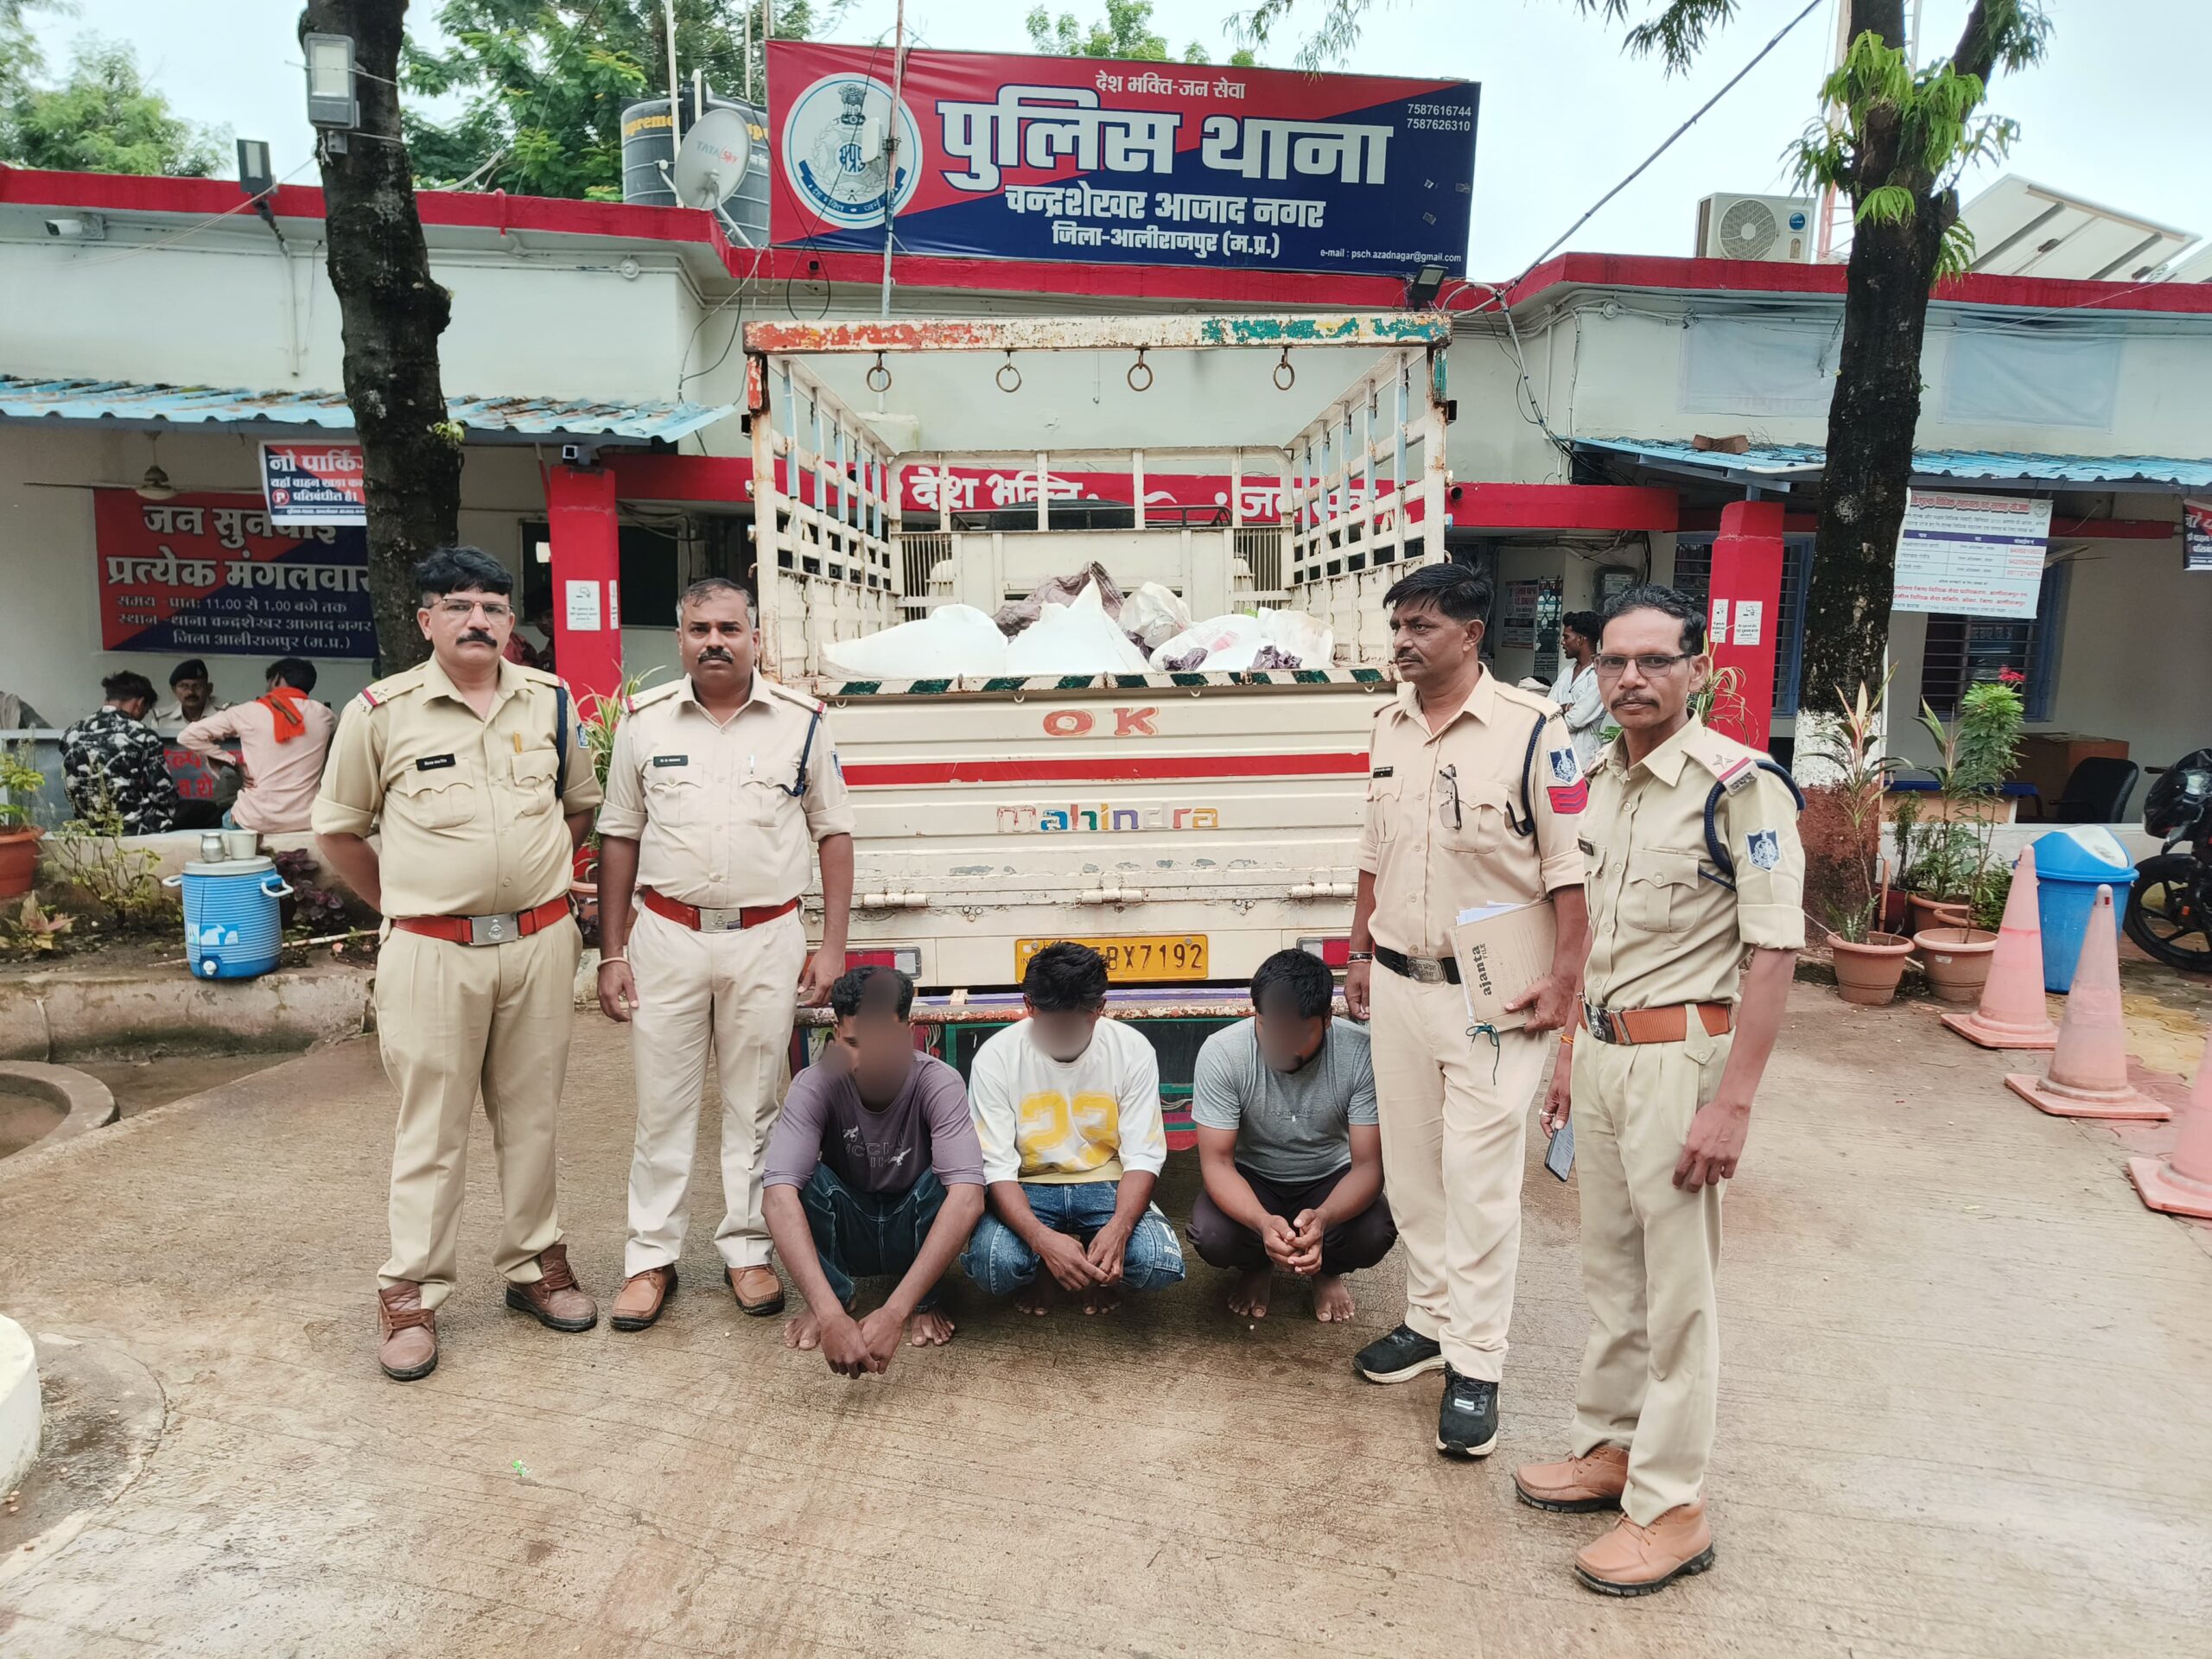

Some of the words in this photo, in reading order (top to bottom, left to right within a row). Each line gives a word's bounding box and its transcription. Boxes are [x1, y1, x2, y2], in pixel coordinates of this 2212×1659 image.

[1096, 70, 1122, 92] देश
[1212, 76, 1245, 99] सेवा
[1408, 103, 1472, 117] 7587616744
[937, 84, 1180, 192] पुलिस
[1201, 115, 1394, 185] थाना
[1407, 118, 1471, 131] 7587626310
[696, 140, 720, 156] TATA
[1005, 181, 1147, 218] चन्द्रशेखर
[1154, 191, 1247, 225] आजाद
[1252, 198, 1325, 228] नगर
[1222, 230, 1281, 258] (म.प्र.)
[1320, 248, 1344, 257] e-mail
[268, 448, 297, 473] नो
[909, 467, 980, 512] देश
[143, 505, 205, 534] जन
[106, 546, 217, 588] प्रत्येक
[118, 596, 156, 607] समय
[207, 599, 241, 610] 11.00
[245, 596, 259, 610] से
[264, 601, 291, 612] 1.00
[321, 603, 347, 613] तक
[118, 613, 157, 625] स्थान
[286, 617, 334, 631] आजाद
[337, 620, 372, 632] नगर
[173, 628, 211, 645] जिला
[214, 632, 299, 652] आलीराजपुर
[996, 801, 1219, 833] mahindra
[1472, 944, 1492, 995] ajanta
